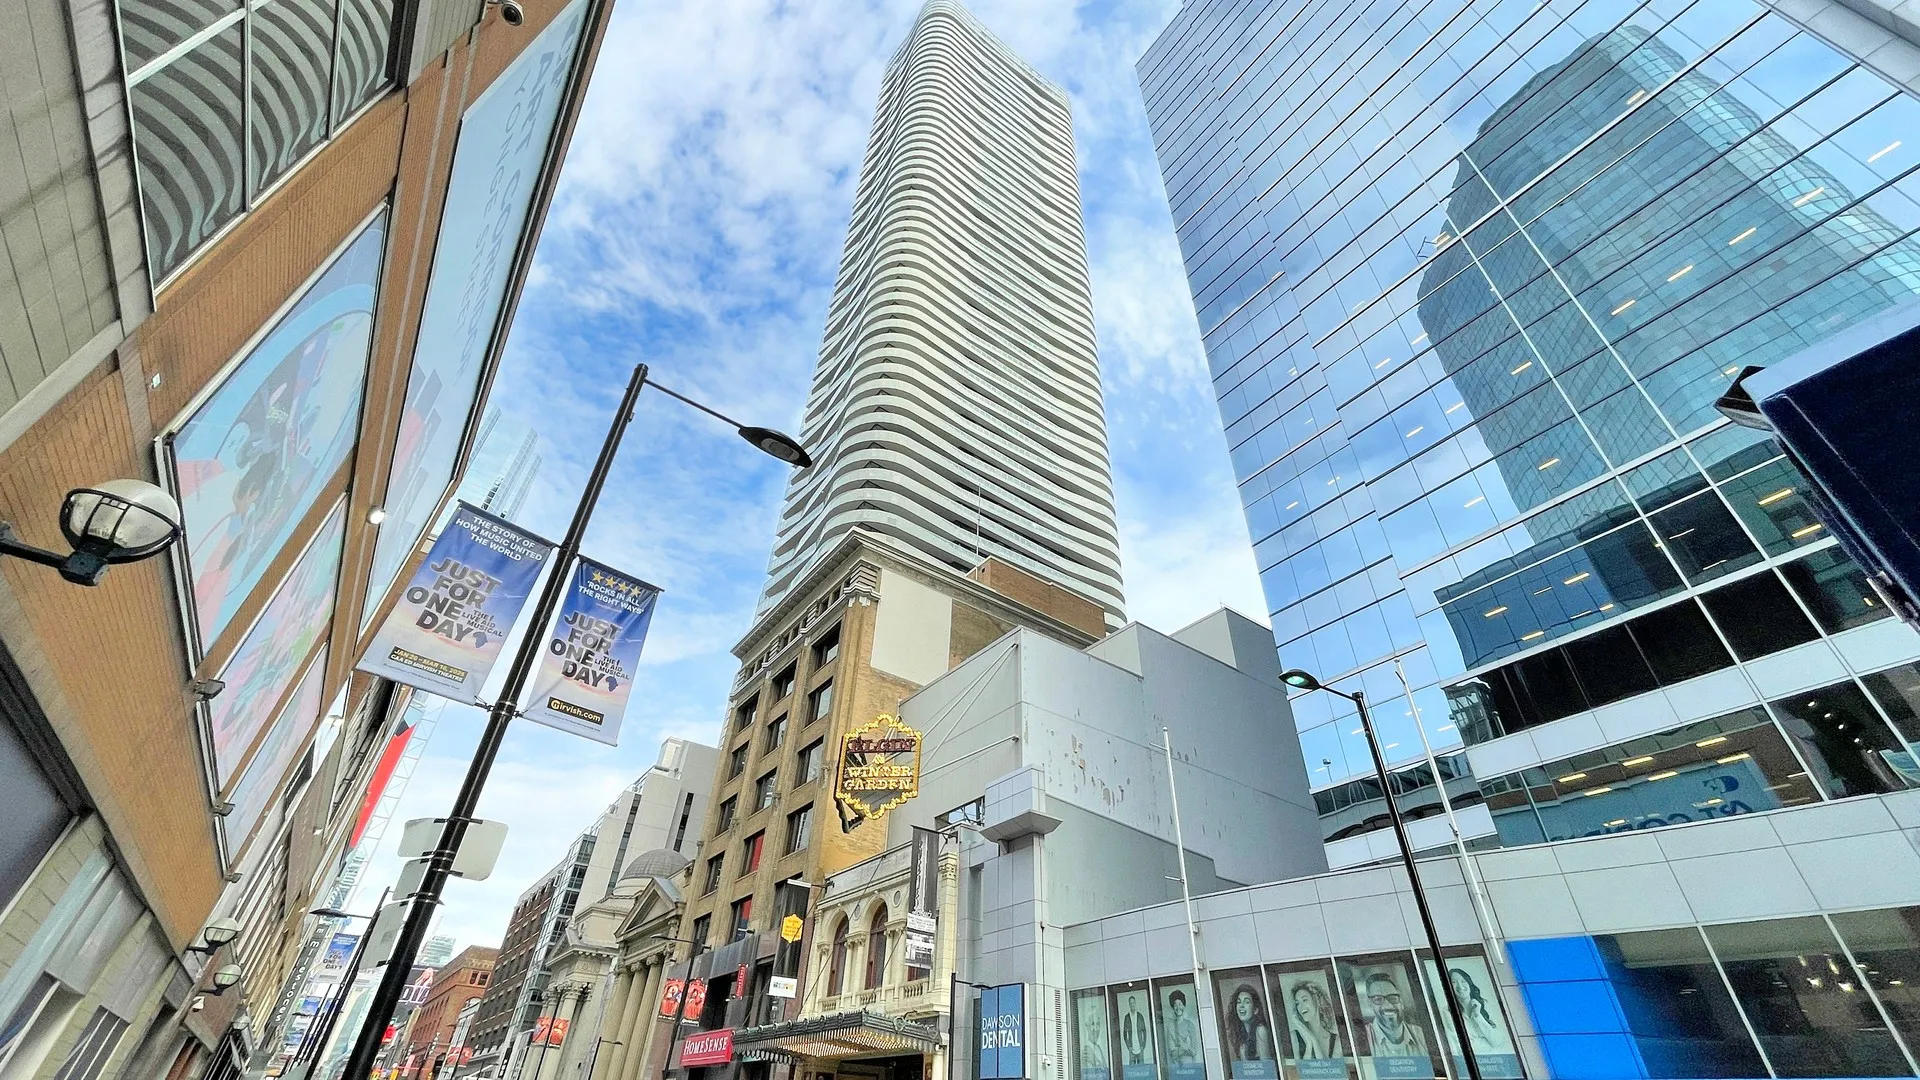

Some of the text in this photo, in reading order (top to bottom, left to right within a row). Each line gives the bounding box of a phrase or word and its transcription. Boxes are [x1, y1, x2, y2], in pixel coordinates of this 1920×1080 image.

[515, 51, 554, 156] ART
[455, 518, 543, 561] HOW MUSIC UNITED
[473, 516, 536, 549] THE STORY OF
[470, 533, 522, 561] THE WORLD
[430, 557, 503, 594] JUST
[406, 586, 465, 620] ONE
[432, 575, 487, 610] FOR
[578, 585, 595, 598] THE
[594, 591, 622, 608] RIGHT
[616, 592, 626, 601] IN
[625, 594, 640, 607] ALL
[415, 609, 474, 642] DAY
[461, 612, 496, 629] LIVE AID
[473, 609, 491, 619] THE
[564, 610, 623, 640] JUST
[466, 620, 503, 637] MUSICAL
[568, 627, 613, 655] FOR
[394, 649, 408, 658] JAN
[422, 658, 439, 668] MAR
[550, 638, 595, 668] ONE
[594, 659, 623, 672] LIVE AID
[603, 656, 616, 664] THE
[390, 654, 404, 663] CAA
[413, 661, 437, 674] MIRVISH
[437, 670, 464, 682] THEATRE
[561, 660, 606, 688] DAY
[599, 666, 630, 680] MUSICAL
[843, 778, 912, 790] GARDEN
[845, 766, 913, 777] WINTER
[275, 940, 320, 1022] milestones
[982, 1013, 1020, 1031] DAWSON
[982, 1028, 1020, 1050] DENTAL
